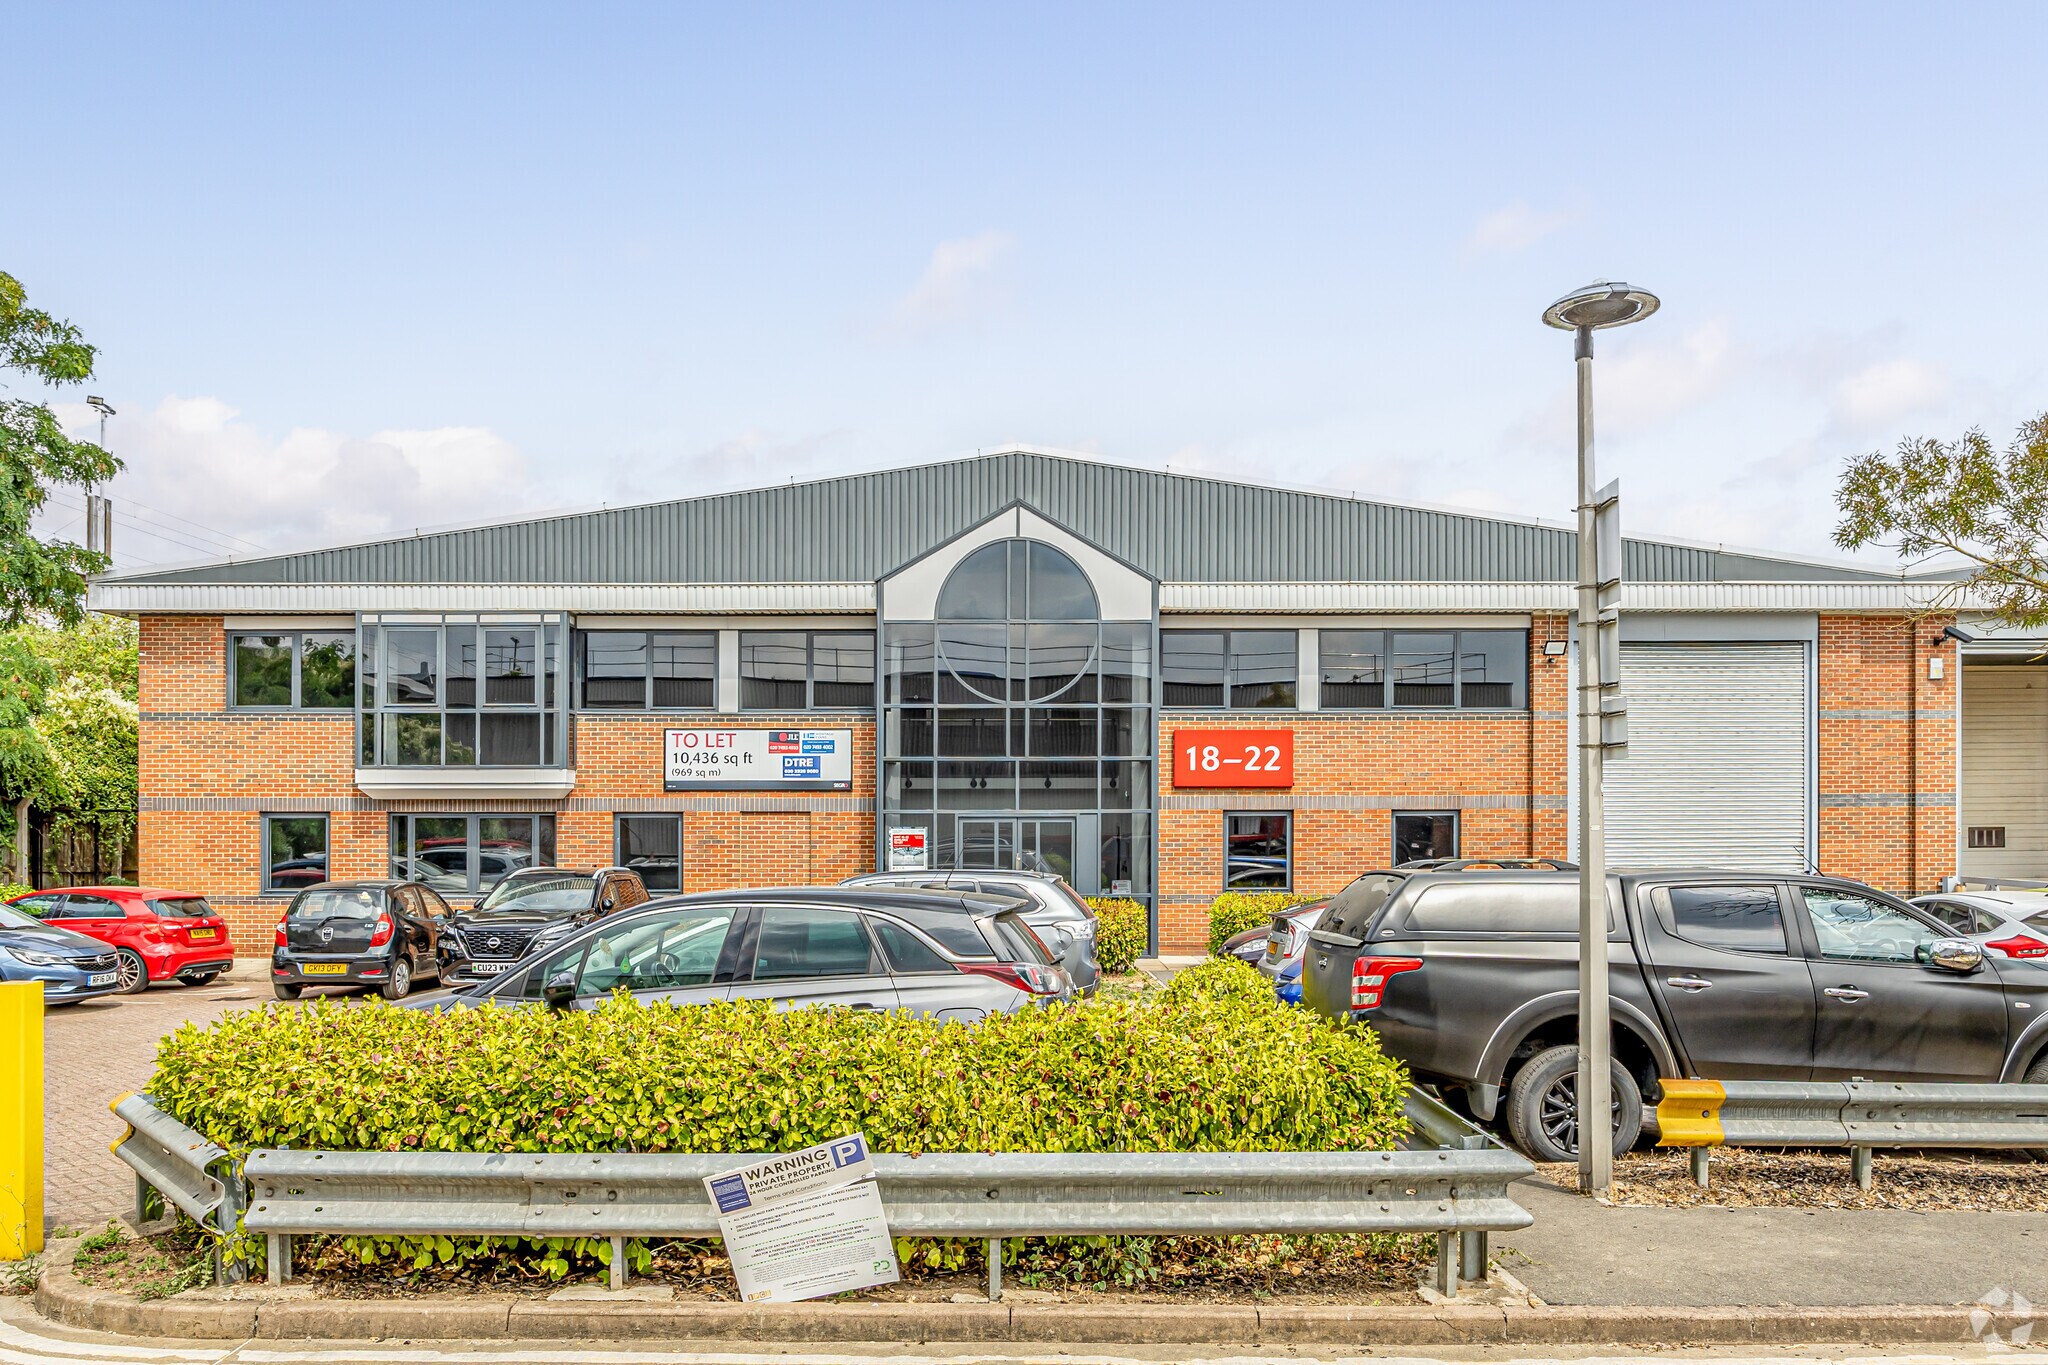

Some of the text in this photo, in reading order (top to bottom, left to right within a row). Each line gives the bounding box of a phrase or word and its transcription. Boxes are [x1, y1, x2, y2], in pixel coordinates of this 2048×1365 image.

[672, 733, 736, 748] TO LET
[674, 752, 752, 766] 10,436 sq ft
[784, 758, 814, 767] DTRE
[672, 768, 721, 778] (969 sq m)
[92, 974, 105, 983] RF16
[745, 1148, 828, 1181] WARNING
[748, 1174, 785, 1190] PRIVATE
[787, 1160, 832, 1179] PROPERTY
[756, 1185, 773, 1193] HOUR
[774, 1174, 810, 1188] CONTROLLED
[810, 1166, 835, 1177] PARKING
[763, 1179, 827, 1202] Terms and Conditions
